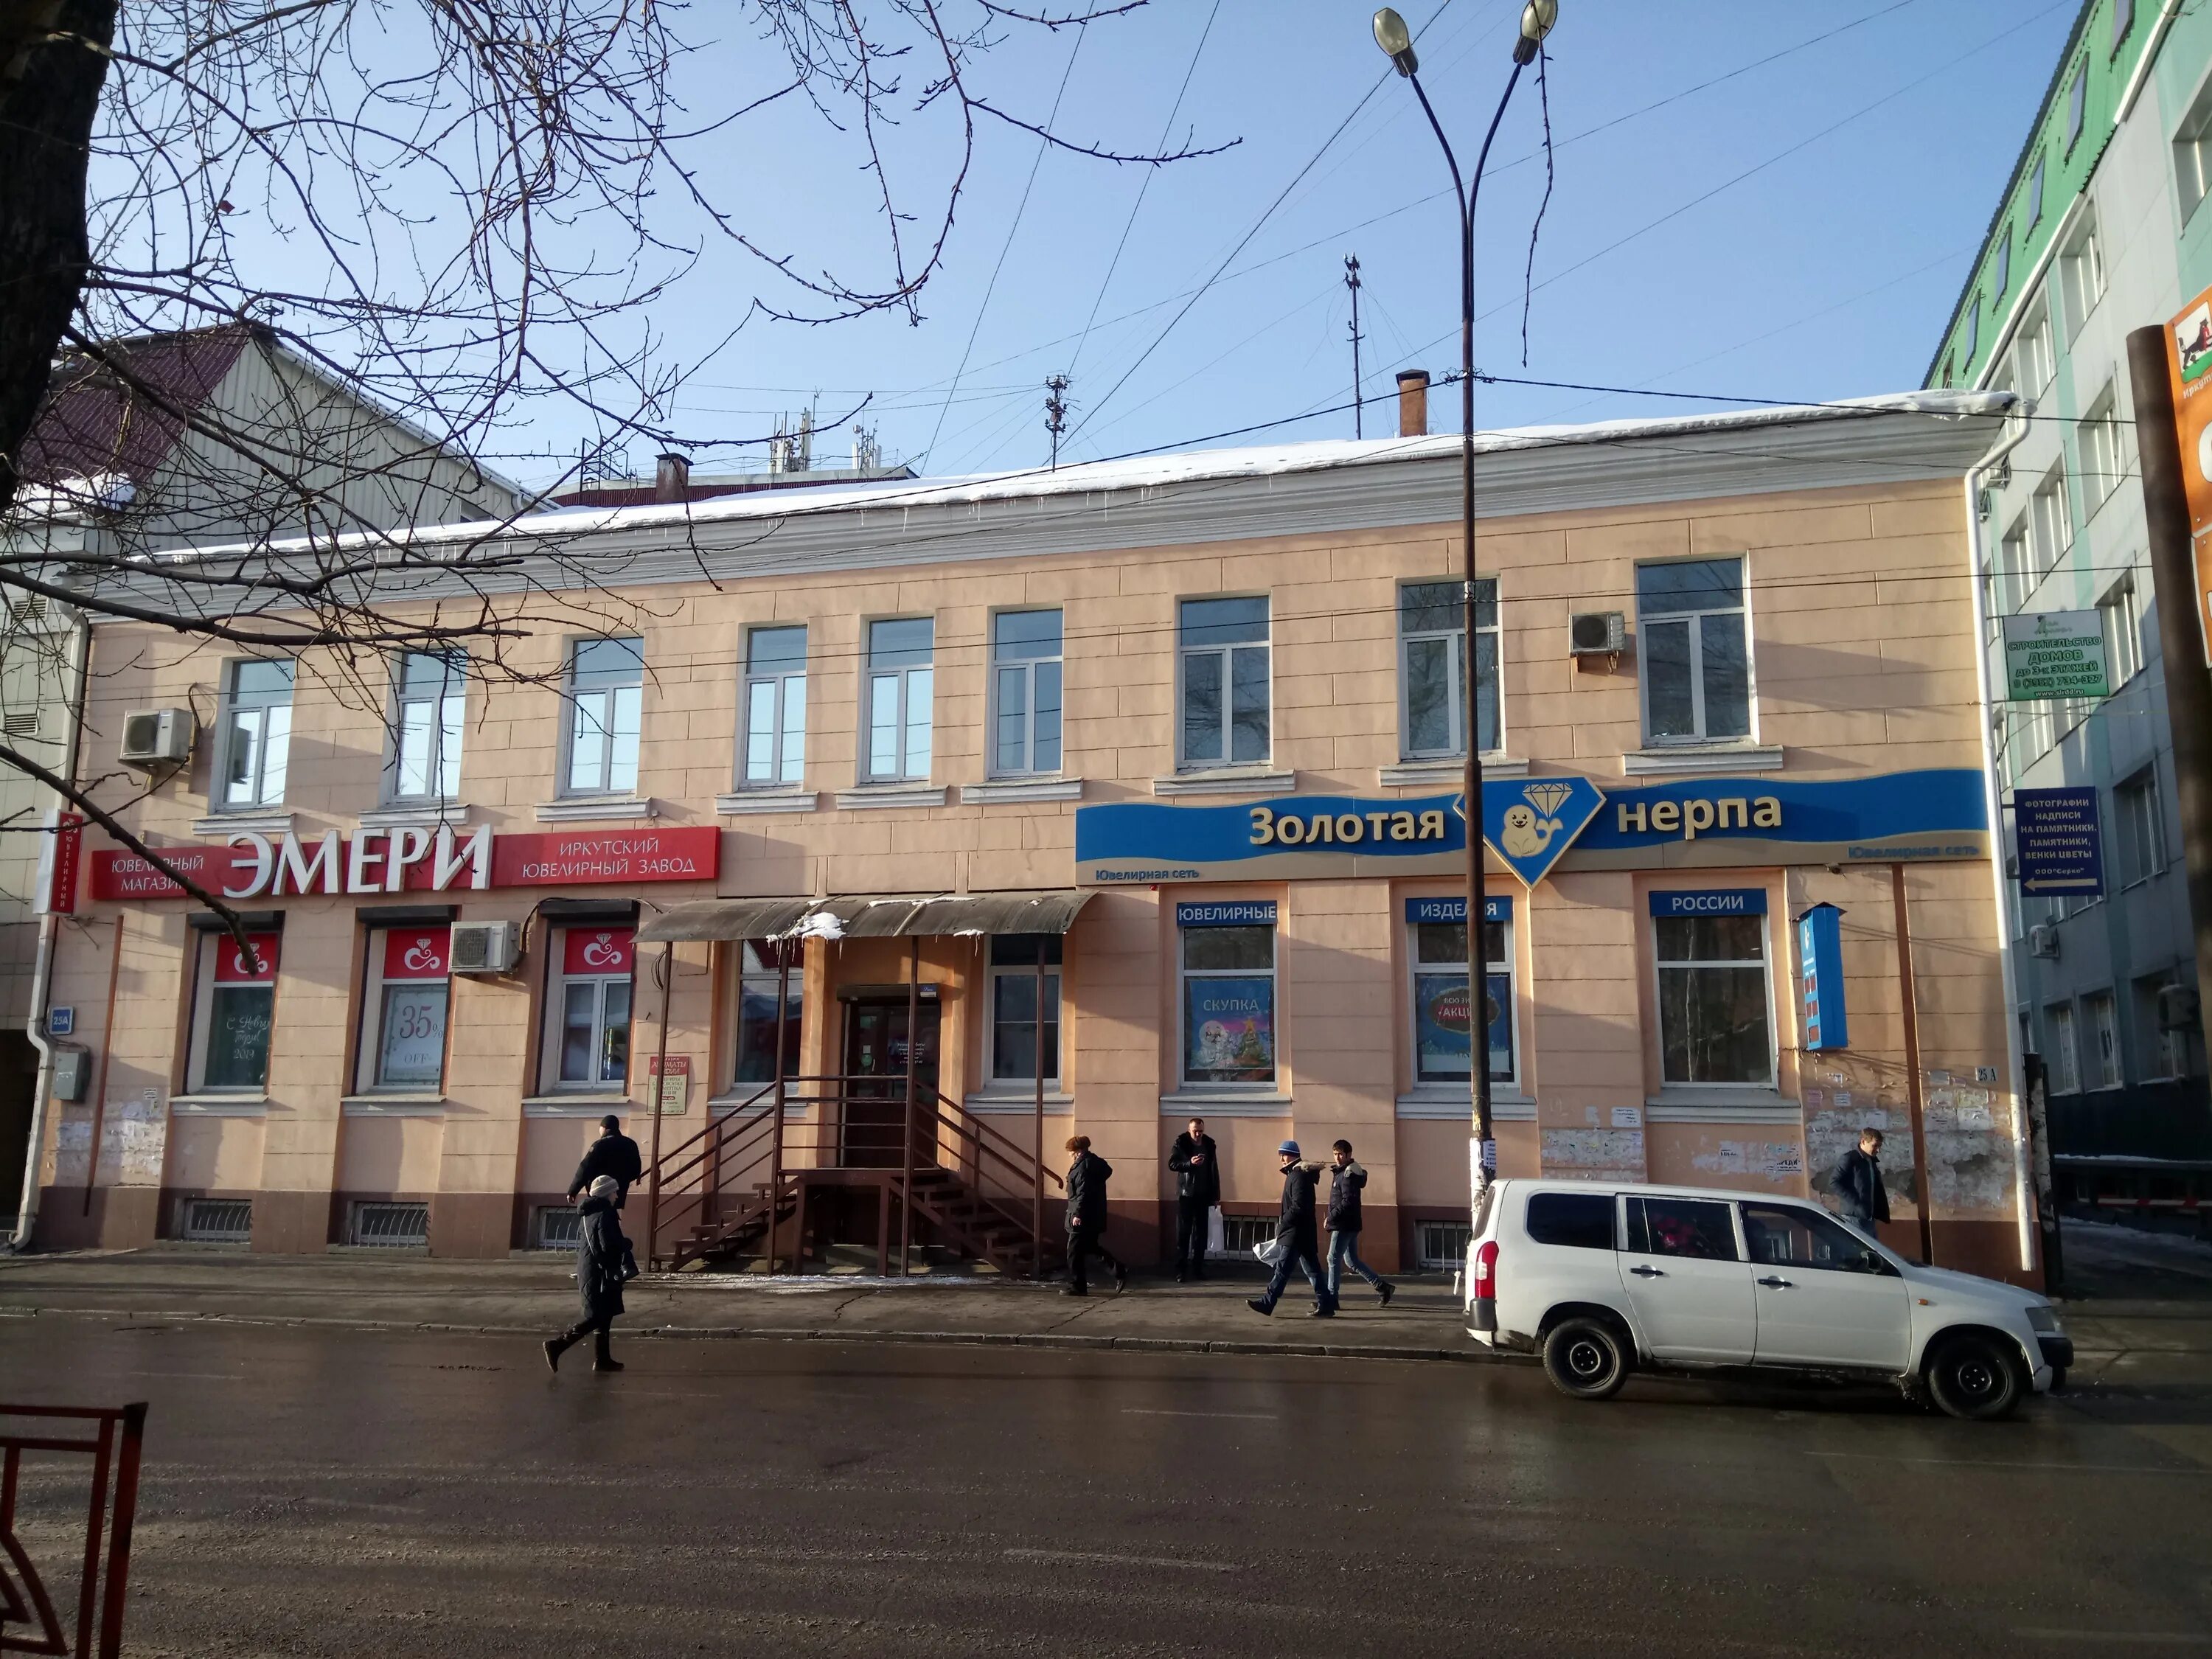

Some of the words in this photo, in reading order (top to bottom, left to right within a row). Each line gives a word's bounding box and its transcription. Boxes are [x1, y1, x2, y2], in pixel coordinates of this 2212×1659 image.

[2008, 636, 2101, 651] СТРОИТЕЛЬСТВО
[2028, 650, 2083, 665] ДОМОВ
[2051, 661, 2098, 674] ЭТАЖЕЙ
[2025, 799, 2090, 808] ФОТОГРАФИИ
[1618, 796, 1782, 841] нерпа
[2035, 811, 2081, 821] НАДПИСИ
[1249, 807, 1444, 845] Золотая
[2020, 825, 2034, 834] НА
[560, 837, 658, 856] ИРКУТСКИЙ
[223, 823, 495, 899] ЭМЕРИ
[2025, 852, 2056, 860] ВЕНКИ
[2059, 850, 2092, 859] ЦВЕТЫ
[60, 835, 73, 908] ЮВЕЛИРНЫЙ
[112, 855, 204, 873] ЮВЕЛРНЫЙ
[523, 858, 628, 878] ЮВЕЛИРНЫЙ
[639, 858, 695, 874] ЗАВОД
[1096, 869, 1169, 882] Ювелирная
[1172, 868, 1200, 879] сеть
[1672, 895, 1744, 911] РОССИИ
[1179, 906, 1276, 921] ЮВЕЛИРНЫЕ
[1203, 998, 1259, 1012] СКУПКА
[53, 1016, 68, 1025] 25А
[233, 1048, 254, 1060] 2019
[1978, 1068, 1988, 1081] 25
[1990, 1068, 1997, 1081] А
